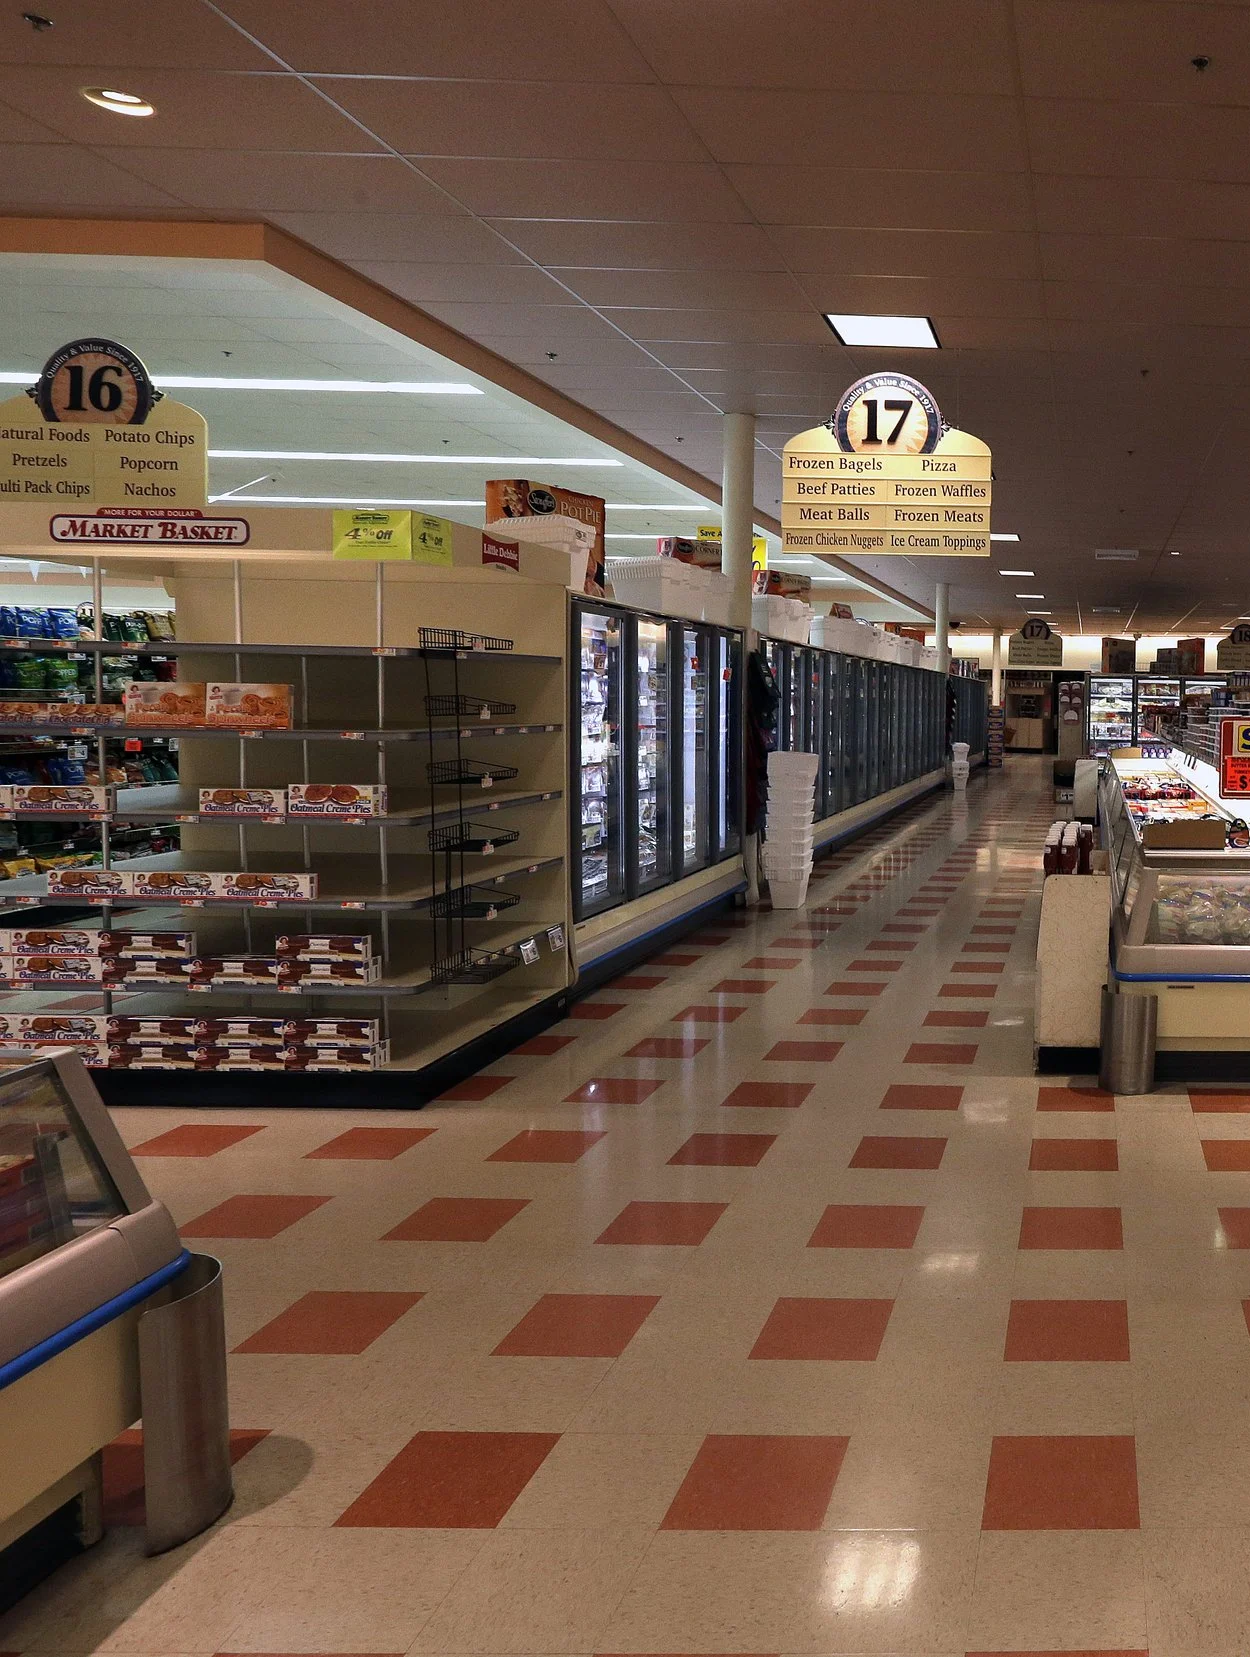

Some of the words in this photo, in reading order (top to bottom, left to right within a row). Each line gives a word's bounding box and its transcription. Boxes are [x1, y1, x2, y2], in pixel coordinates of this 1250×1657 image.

[47, 353, 69, 379] Quality
[79, 343, 103, 352] Value
[107, 346, 128, 363] Since
[128, 362, 144, 382] 1917
[64, 365, 122, 412] 16
[842, 388, 865, 412] Quality
[874, 378, 897, 387] Value
[899, 380, 920, 397] Since
[920, 395, 935, 414] 1917
[861, 399, 913, 445] 17
[0, 427, 43, 441] atural
[49, 428, 90, 443] Foods
[105, 429, 150, 443] Potato
[155, 431, 195, 447] Chips
[12, 453, 67, 467] Pretzels
[120, 456, 179, 473] Popcorn
[789, 456, 834, 470] Frozen
[839, 457, 882, 473] Bagels
[922, 459, 957, 472] Pizza
[0, 480, 21, 493] ulti
[24, 480, 52, 493] Pack
[56, 481, 90, 497] Chips
[124, 482, 177, 497] Nachos
[797, 482, 827, 495] Beef
[831, 483, 875, 496] Patties
[895, 484, 937, 497] Frozen
[942, 484, 986, 497] Waffles
[145, 509, 165, 517] YOUR
[560, 501, 585, 518] POT
[585, 506, 601, 523] PIE
[800, 508, 833, 520] Meat
[838, 508, 870, 521] Balls
[894, 509, 939, 522] Frozen
[944, 510, 984, 523] Meats
[60, 519, 153, 539] MARKET
[158, 521, 238, 540] BASKET
[376, 529, 394, 540] Off
[700, 529, 716, 537] Save
[786, 532, 813, 545] Frozen
[816, 533, 848, 546] Chicken
[850, 534, 884, 549] Nuggets
[891, 535, 905, 547] Ice
[908, 535, 940, 547] Cream
[943, 535, 986, 550] Toppings
[483, 543, 499, 556] Little
[499, 547, 518, 561] Debbie
[1030, 625, 1043, 637] 17
[20, 801, 53, 809] Oatmeal
[54, 801, 79, 809] Creme
[80, 801, 99, 809] Pies
[290, 803, 324, 812] Oatmeal
[326, 804, 351, 812] Creme
[352, 804, 371, 813] Pies
[17, 945, 50, 953] Oatmeal
[51, 945, 76, 954] Creme
[76, 946, 94, 954] Pies
[85, 1057, 103, 1065] Pies
